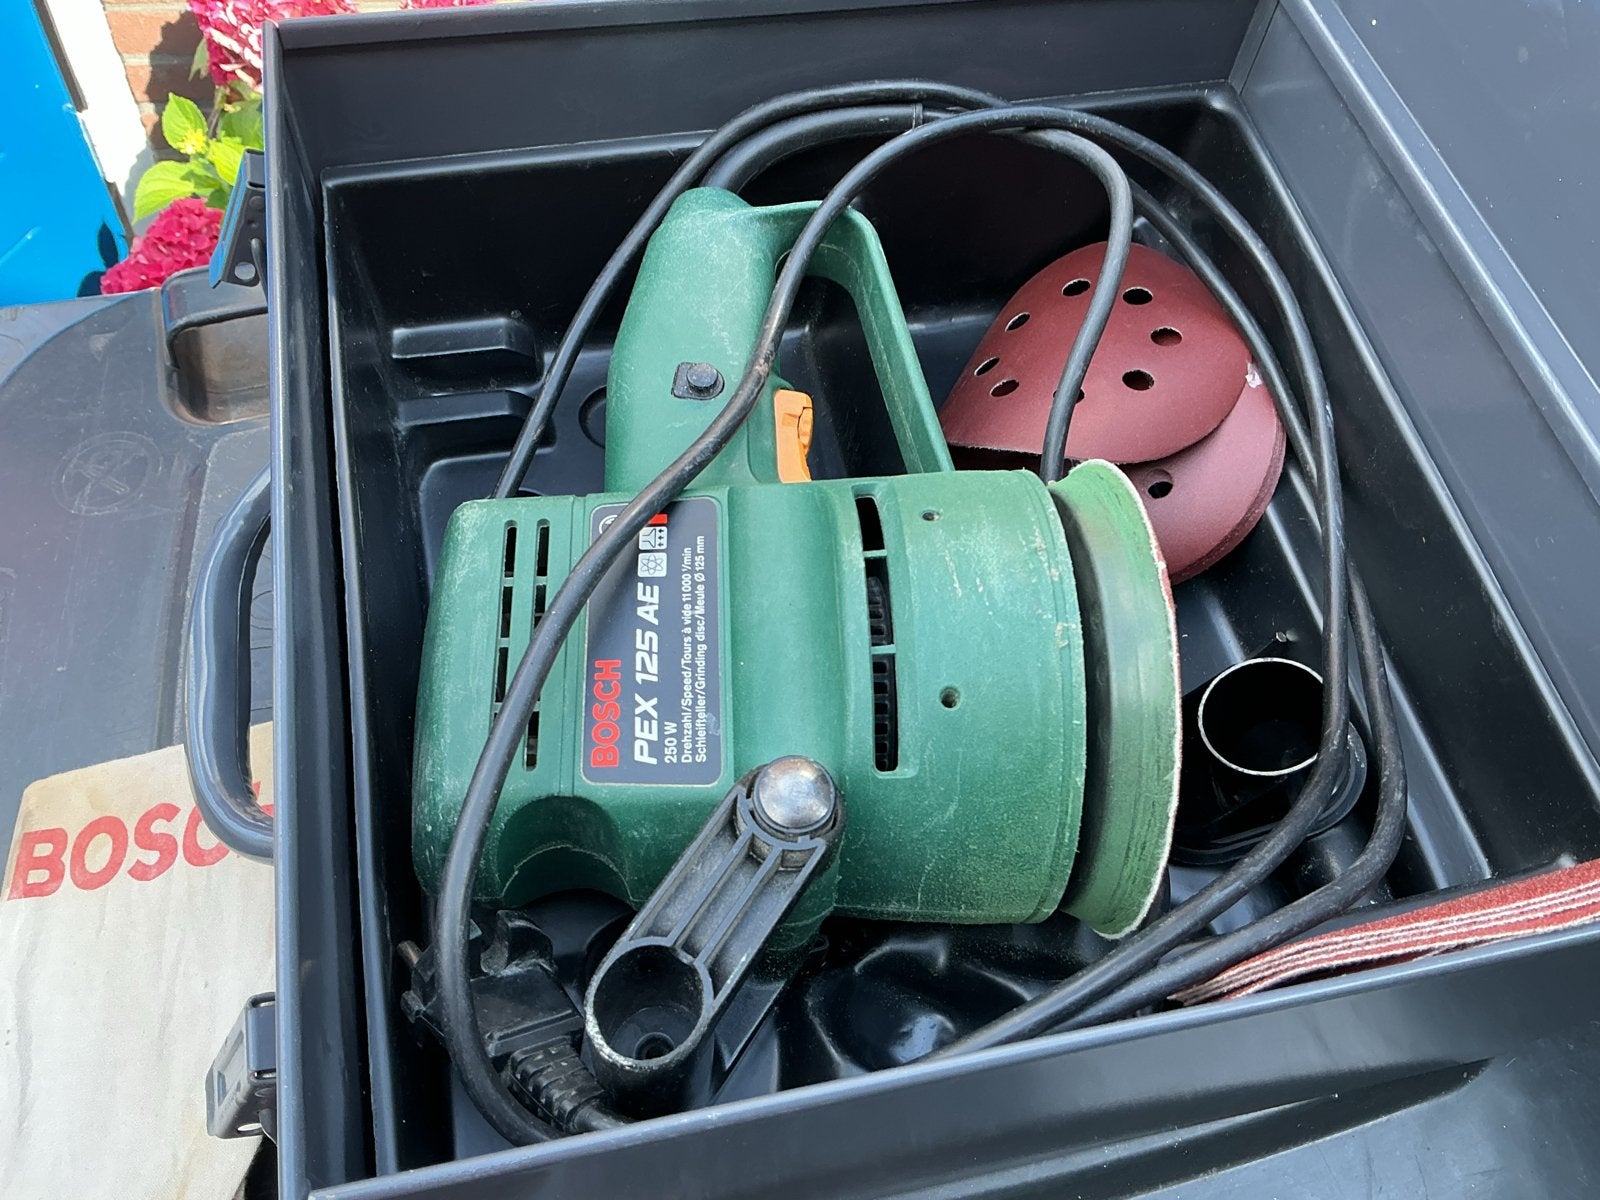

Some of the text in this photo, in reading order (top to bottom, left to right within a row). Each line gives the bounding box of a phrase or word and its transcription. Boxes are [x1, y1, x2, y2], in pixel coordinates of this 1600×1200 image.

[695, 556, 706, 571] 125
[696, 536, 706, 554] mm
[681, 604, 692, 625] vide
[694, 584, 706, 641] disc/Meule
[634, 583, 660, 765] PEX 125 AE
[681, 636, 694, 763] Drehzahl/Speed/Tours
[591, 660, 622, 768] BOSCH
[664, 721, 677, 763] 250 W
[8, 781, 274, 901] BOSC
